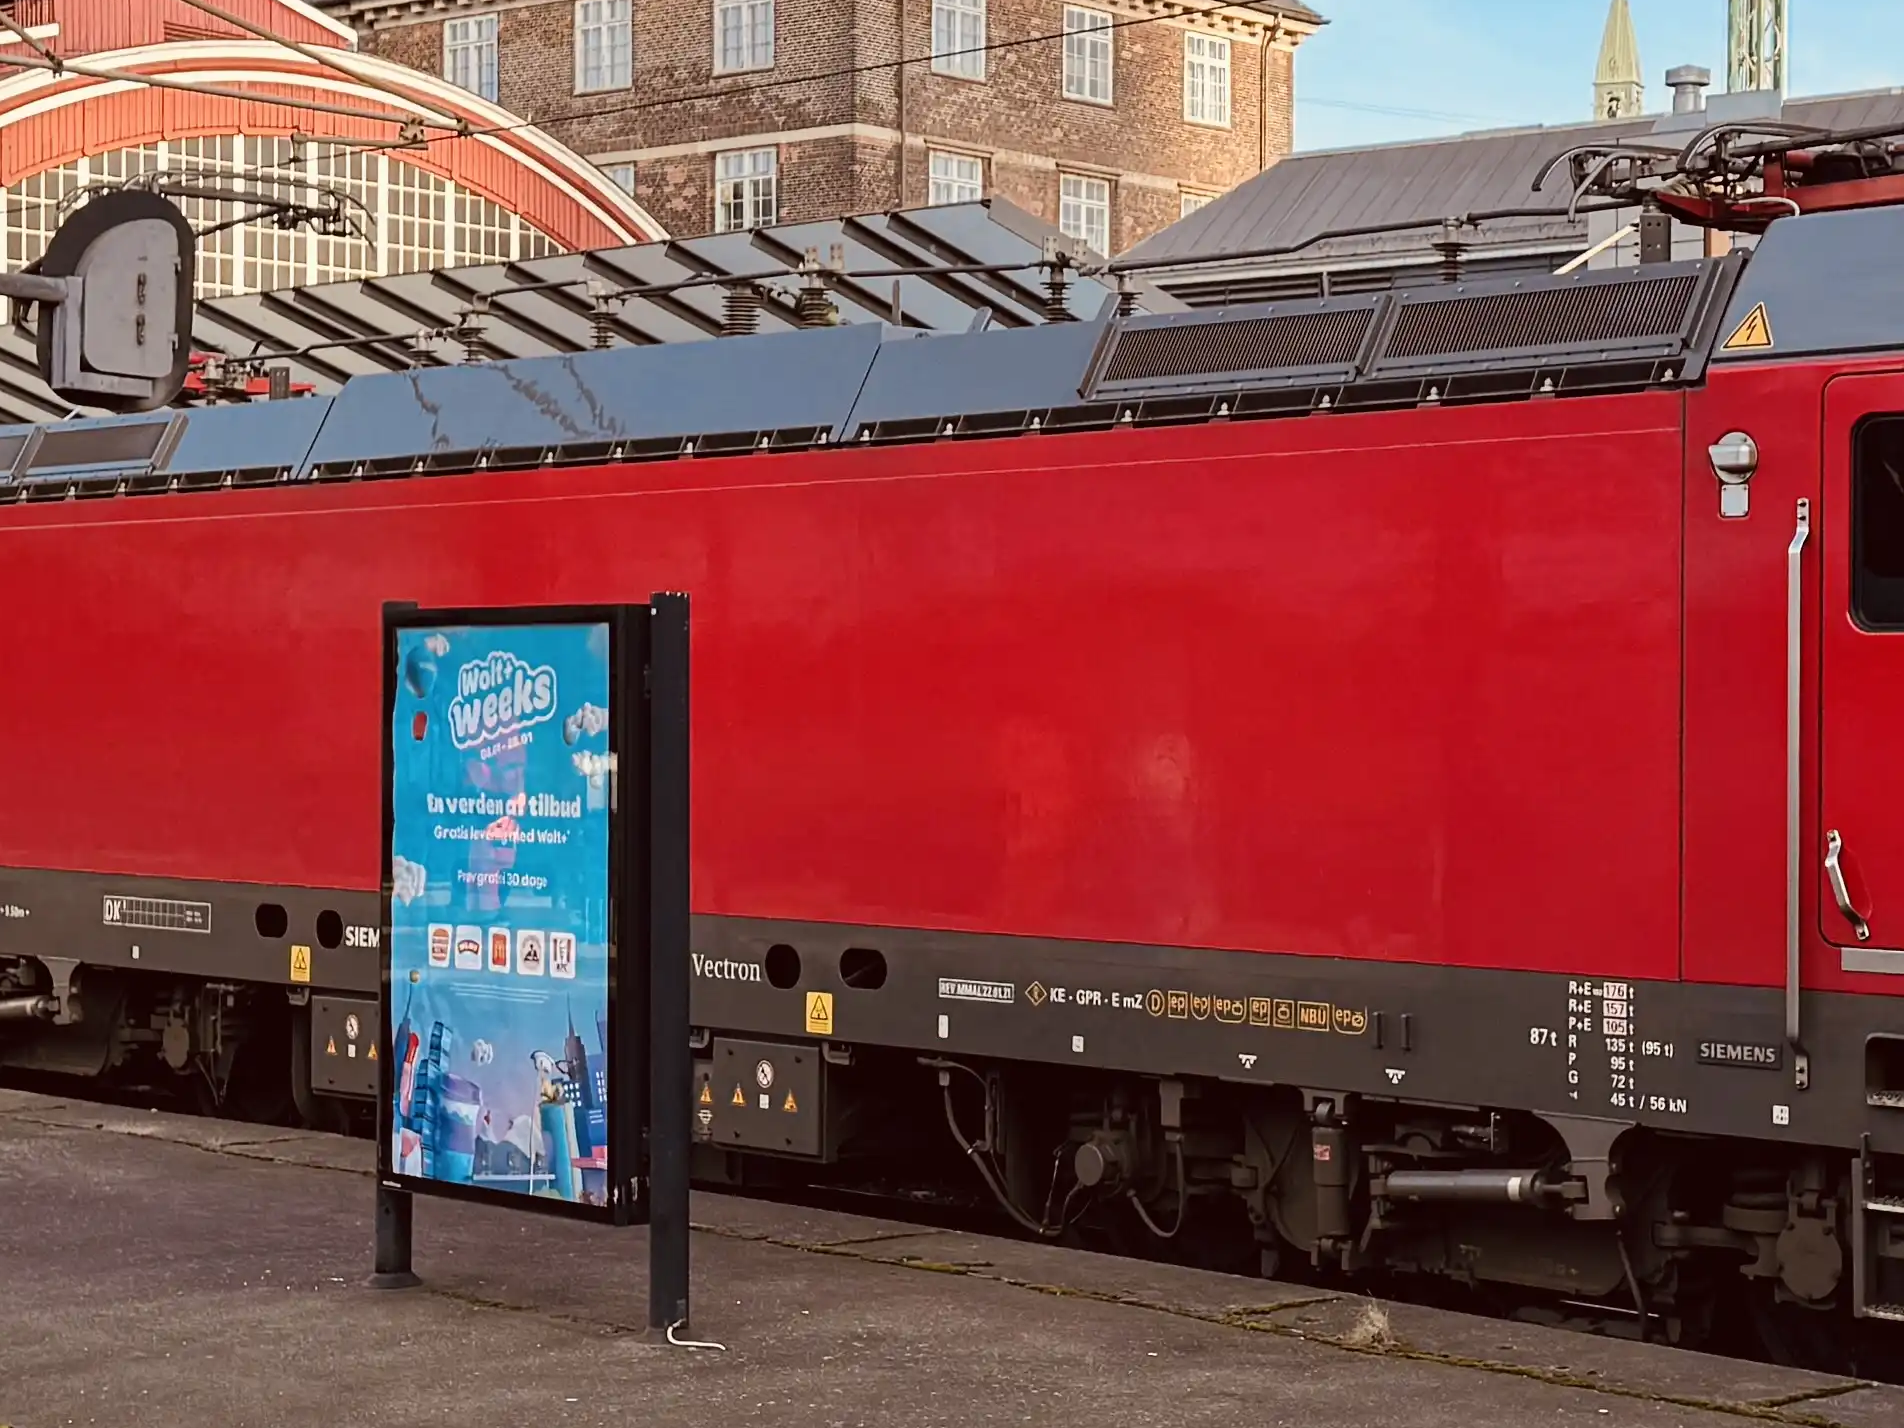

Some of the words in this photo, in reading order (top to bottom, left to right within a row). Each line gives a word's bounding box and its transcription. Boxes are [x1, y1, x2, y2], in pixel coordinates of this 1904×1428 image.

[461, 659, 513, 696] Wolt+
[427, 793, 444, 813] En
[445, 791, 503, 815] verden
[505, 792, 526, 816] af
[528, 792, 582, 818] tilbud
[433, 824, 468, 839] Gratis
[507, 872, 520, 886] 30
[691, 953, 761, 982] Vectron
[1049, 987, 1066, 1003] KE
[1076, 989, 1101, 1006] GPR
[1111, 992, 1120, 1008] E
[1123, 993, 1143, 1009] mZ
[1605, 984, 1625, 997] 176
[1628, 987, 1634, 999] t
[1605, 1002, 1625, 1015] 157
[1628, 1005, 1634, 1017] t
[1605, 1020, 1625, 1033] 105
[1628, 1023, 1634, 1035] t
[1568, 1034, 1577, 1048] R
[1605, 1038, 1626, 1052] 135
[1628, 1041, 1634, 1053] t
[1641, 1041, 1661, 1056] (95
[1664, 1043, 1674, 1058] t)
[1700, 1042, 1776, 1063] SIEMENS
[1568, 1052, 1577, 1066] P
[1610, 1056, 1626, 1070] 95
[1628, 1059, 1634, 1071] t
[1568, 1070, 1578, 1084] G
[1610, 1074, 1626, 1089] 72
[1628, 1078, 1634, 1090] t
[1610, 1092, 1626, 1106] 45
[1628, 1096, 1634, 1108] t
[1649, 1096, 1666, 1111] 56
[1669, 1099, 1687, 1114] kN
